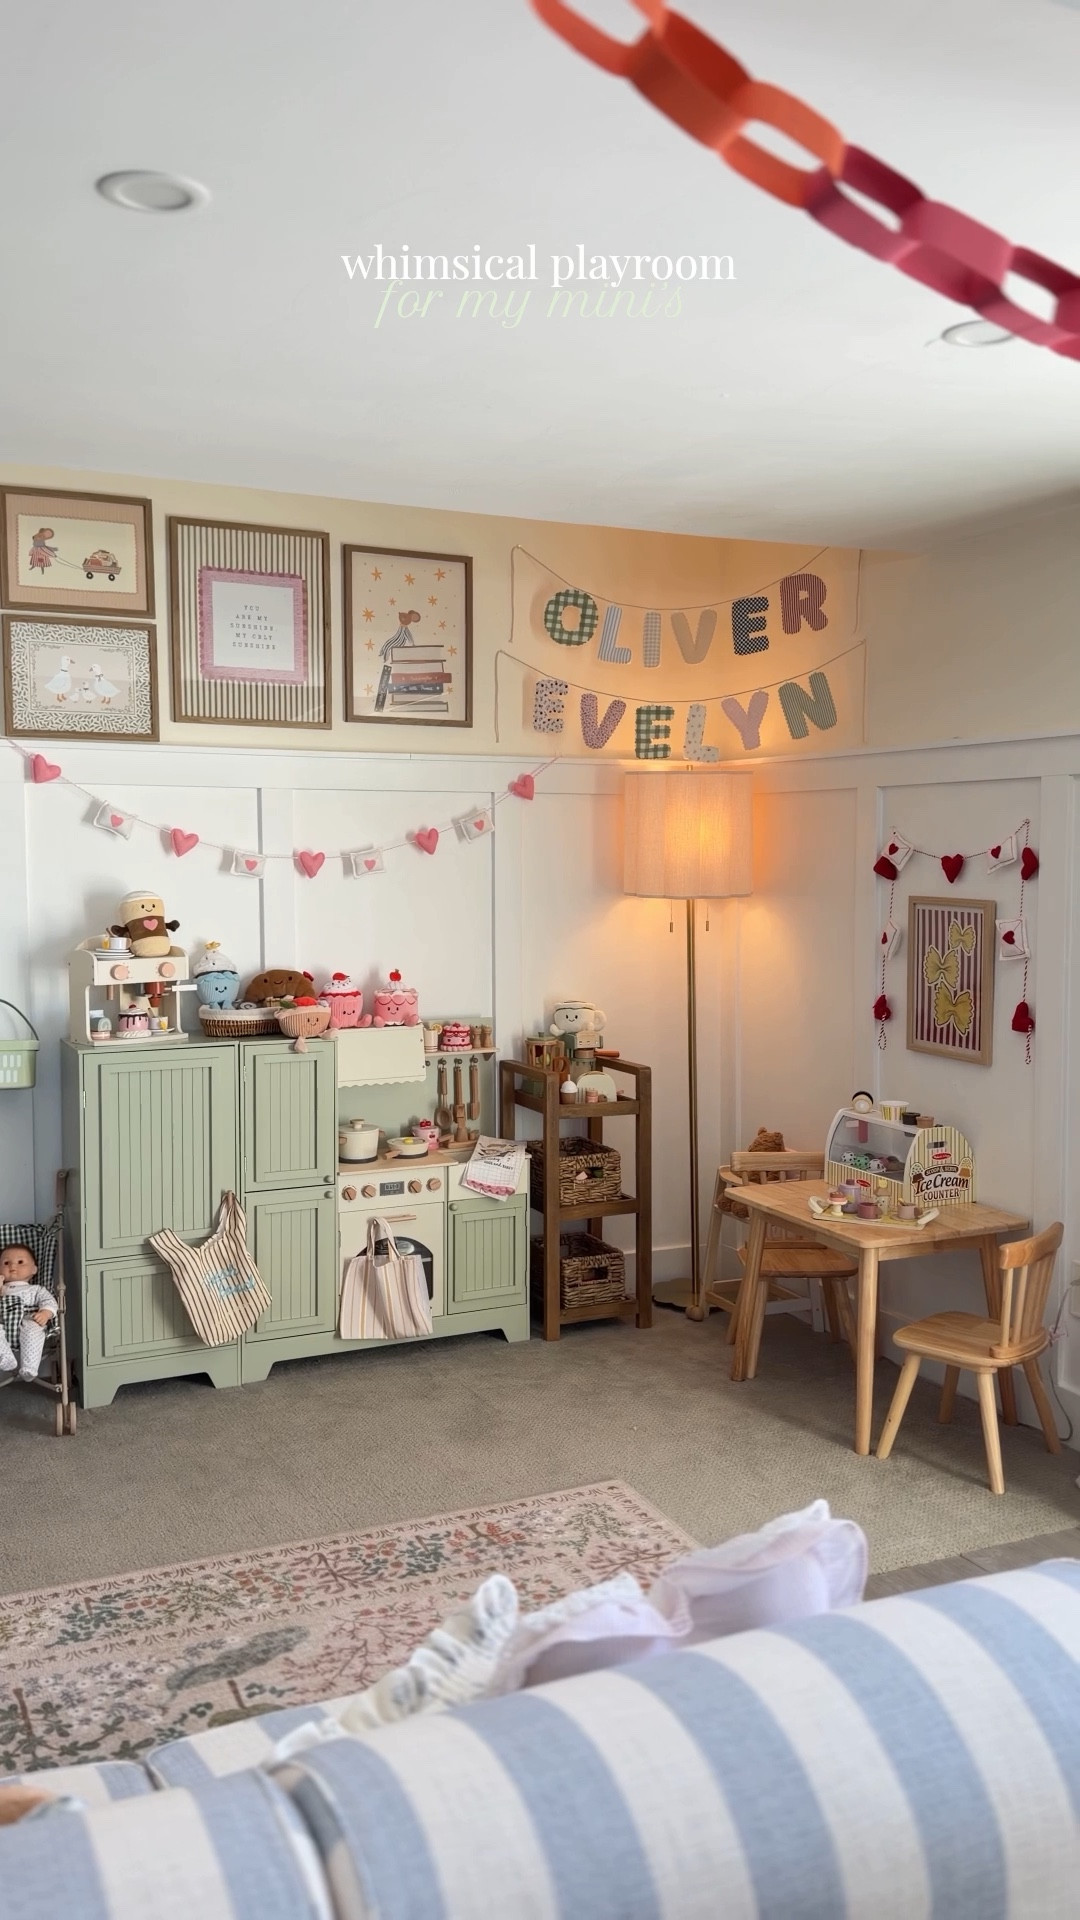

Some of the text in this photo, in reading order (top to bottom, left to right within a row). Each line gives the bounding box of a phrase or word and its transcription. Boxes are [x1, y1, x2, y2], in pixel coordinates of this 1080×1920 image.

[543, 573, 829, 668] OLIVER
[533, 671, 838, 763] EVELYN
[915, 1174, 969, 1195] Ice Cream
[923, 1188, 960, 1201] COUNTER
